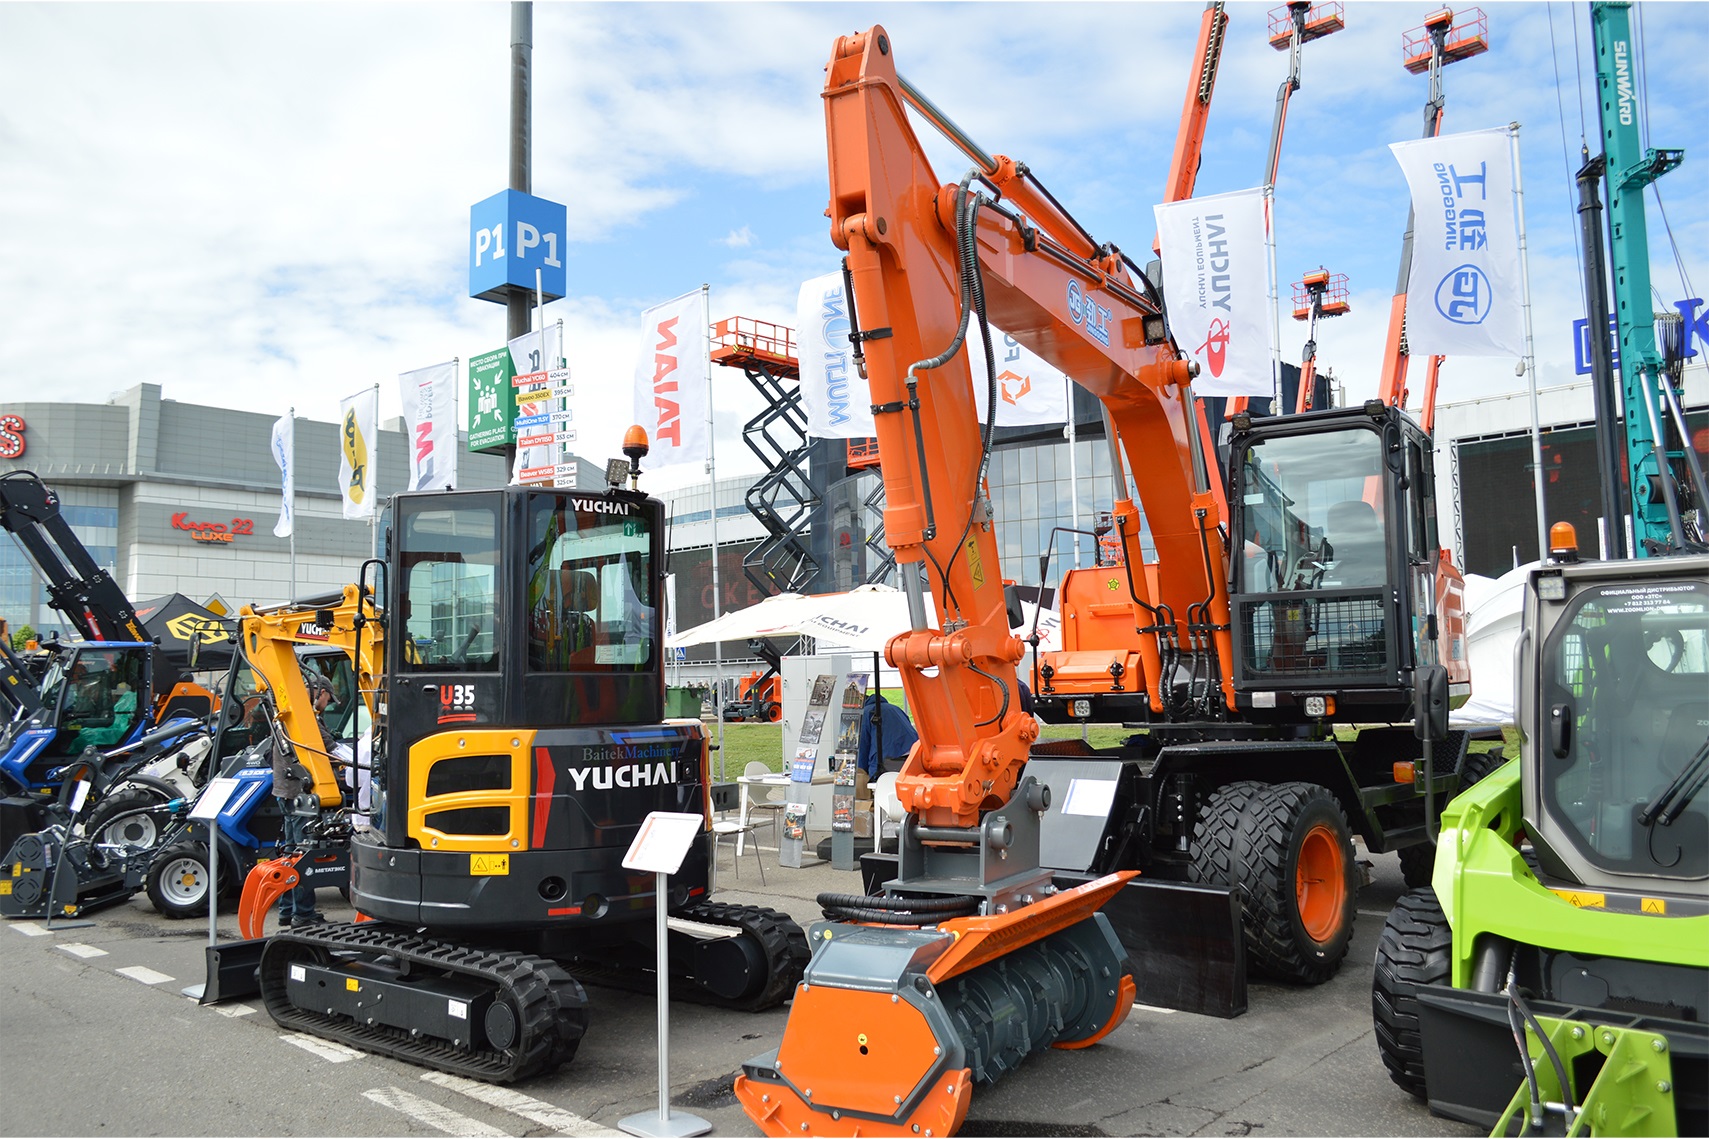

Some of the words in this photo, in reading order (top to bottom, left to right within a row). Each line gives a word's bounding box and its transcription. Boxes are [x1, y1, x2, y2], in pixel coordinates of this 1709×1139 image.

[1614, 41, 1636, 126] SUNWARD
[475, 223, 505, 267] P1
[516, 221, 561, 268] P1
[514, 375, 531, 384] Yuchai
[535, 391, 550, 400] 350EX
[469, 429, 491, 441] GATHERING
[492, 425, 506, 435] PLACE
[470, 440, 479, 448] FOR
[479, 433, 505, 446] EVACUATION
[520, 438, 535, 446] Taian
[520, 470, 538, 478] Beaver
[571, 498, 629, 515] YUCHAI
[231, 517, 254, 535] 22
[191, 531, 234, 542] LUXE
[1600, 587, 1646, 596] ОФИЦИАЛЬНЫЙ
[1646, 585, 1695, 594] ДИСТРИБЬЮТОР
[440, 684, 475, 705] U35
[568, 761, 677, 791] YUCHAI
[315, 866, 346, 874] МЕТАТЭКС
